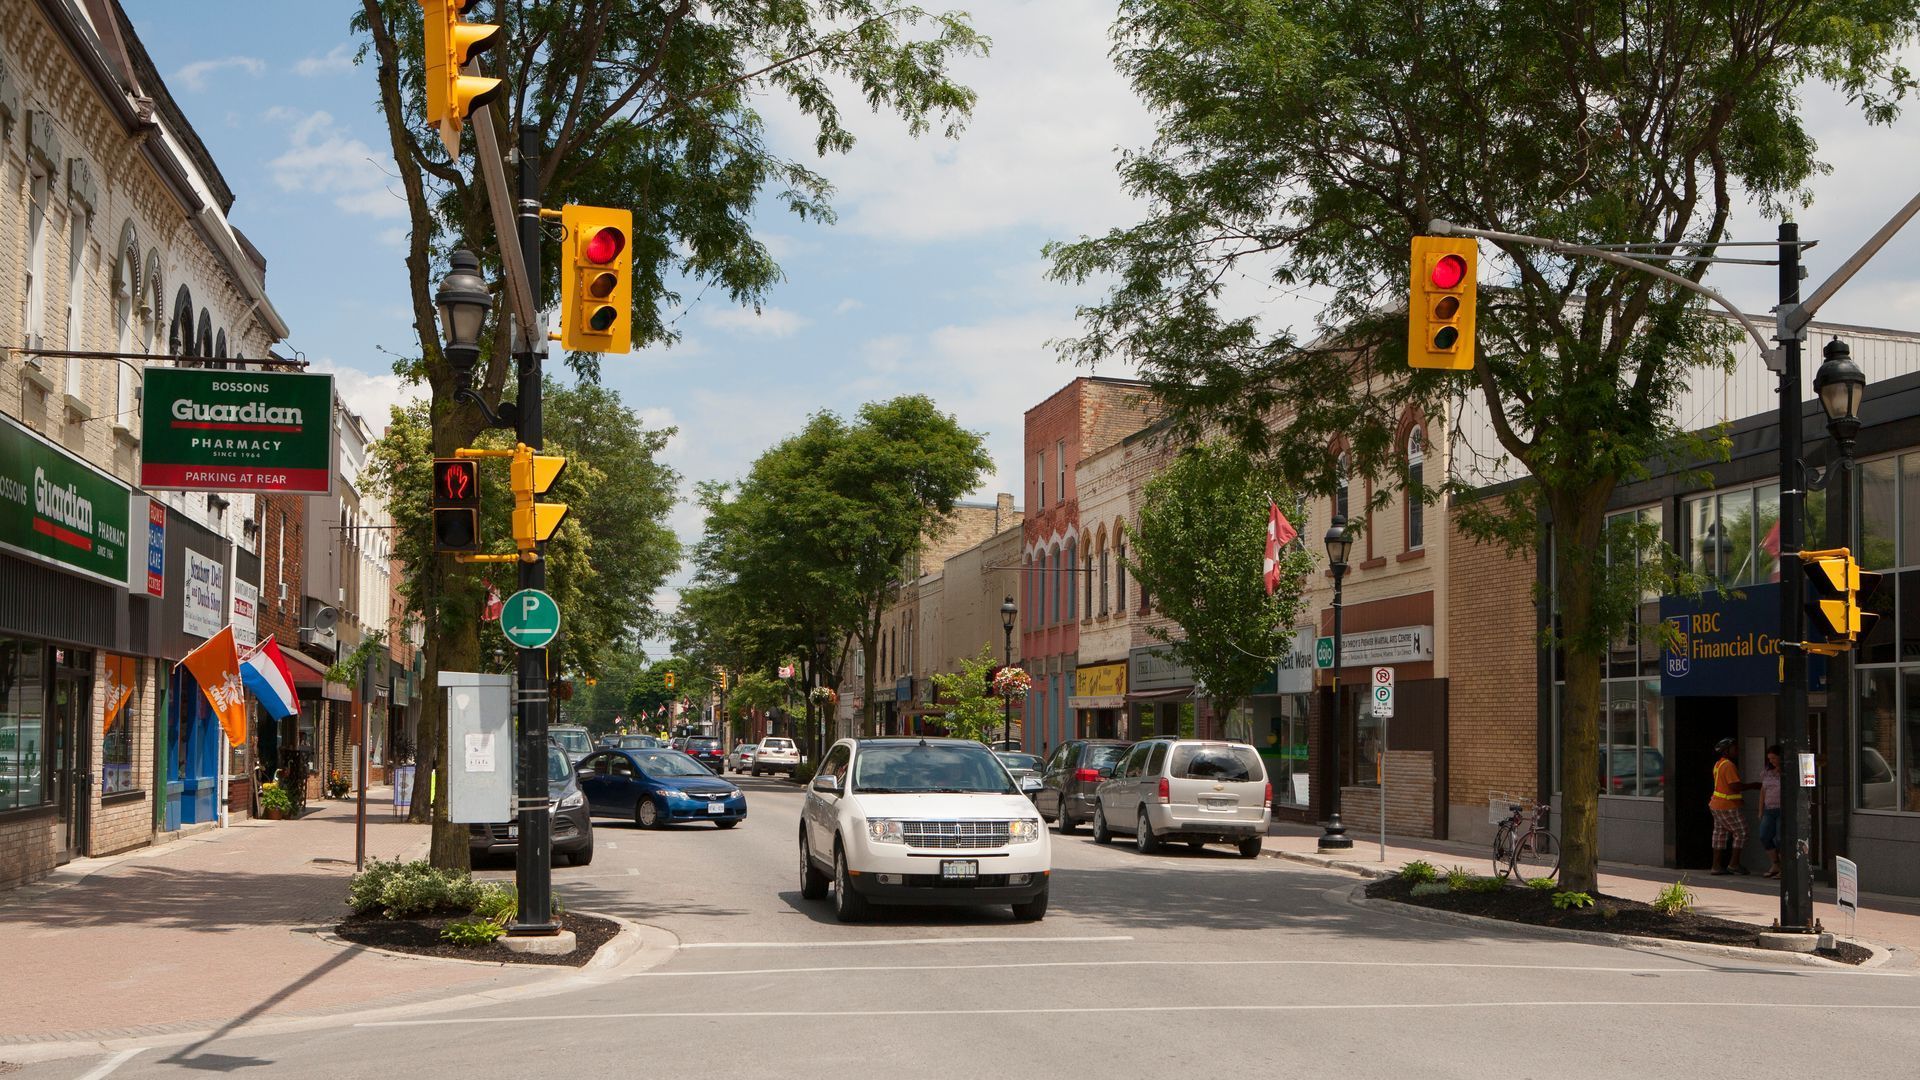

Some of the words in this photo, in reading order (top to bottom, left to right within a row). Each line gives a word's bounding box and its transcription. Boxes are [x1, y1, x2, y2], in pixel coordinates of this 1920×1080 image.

[212, 382, 269, 393] BOSSONS
[172, 398, 303, 425] Guardian
[192, 438, 282, 450] PHARMACY
[186, 472, 236, 482] PARKING
[240, 473, 252, 483] AT
[256, 474, 287, 484] REAR
[0, 475, 27, 506] OSSONS
[34, 466, 93, 534] Guardian
[98, 520, 126, 548] PHARMACY
[210, 564, 222, 590] Deli
[522, 596, 540, 621] P
[1692, 612, 1721, 634] RBC
[1398, 634, 1412, 642] CENTRE
[1692, 632, 1754, 660] Financial
[1757, 633, 1781, 656] Gro
[1294, 650, 1312, 668] Wave
[1318, 644, 1332, 664] dojo
[1669, 658, 1688, 672] RBC
[1380, 690, 1386, 698] P
